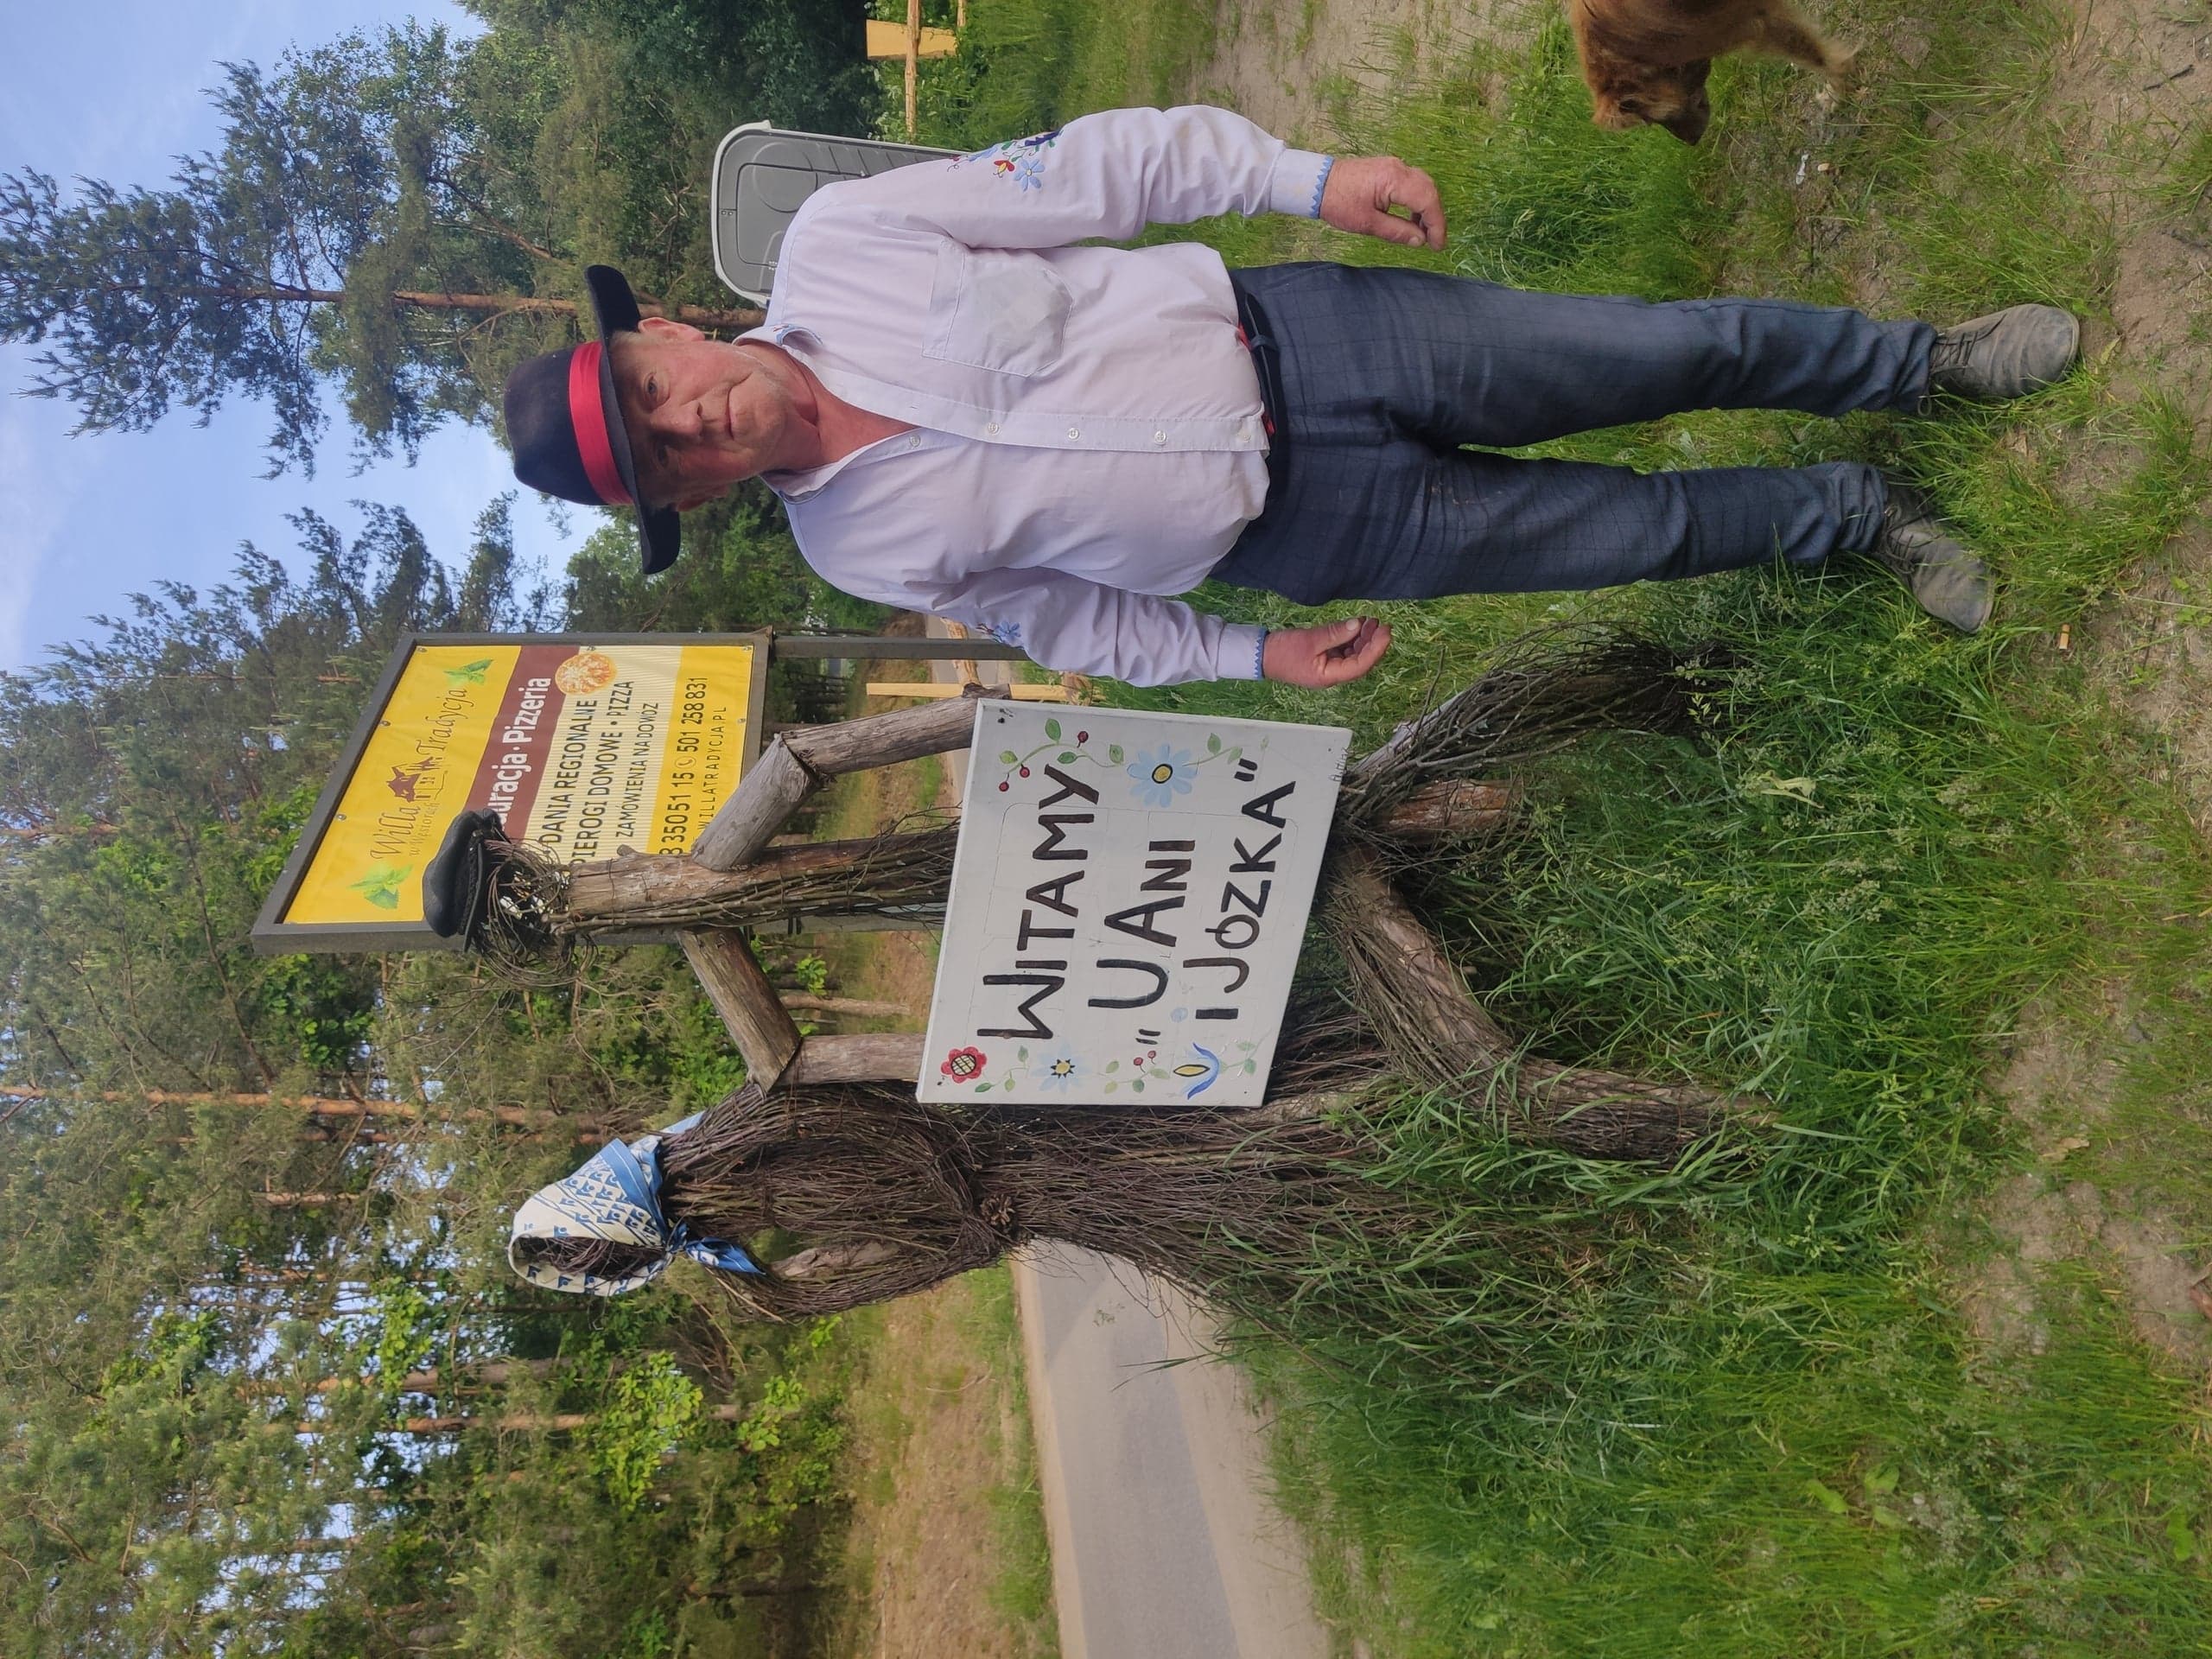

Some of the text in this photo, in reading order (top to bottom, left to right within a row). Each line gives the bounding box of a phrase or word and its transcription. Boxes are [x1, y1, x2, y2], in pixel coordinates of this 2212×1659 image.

[587, 731, 623, 796] DOMOWE
[606, 680, 635, 717] PIZZA
[676, 730, 701, 753] 501
[681, 702, 705, 725] 258
[685, 677, 709, 699] 831
[370, 688, 474, 859] Willa Tradycja
[486, 677, 551, 831] uracja Pizzeria
[538, 699, 598, 844] DANIA REGIONALNE
[614, 702, 659, 838] ZAMÓWIENIA NA DOWÓZ
[667, 793, 692, 812] 51
[671, 771, 695, 788] 15
[661, 813, 689, 844] 350
[976, 763, 1100, 1039] WITAMY
[1103, 839, 1196, 948] ANI
